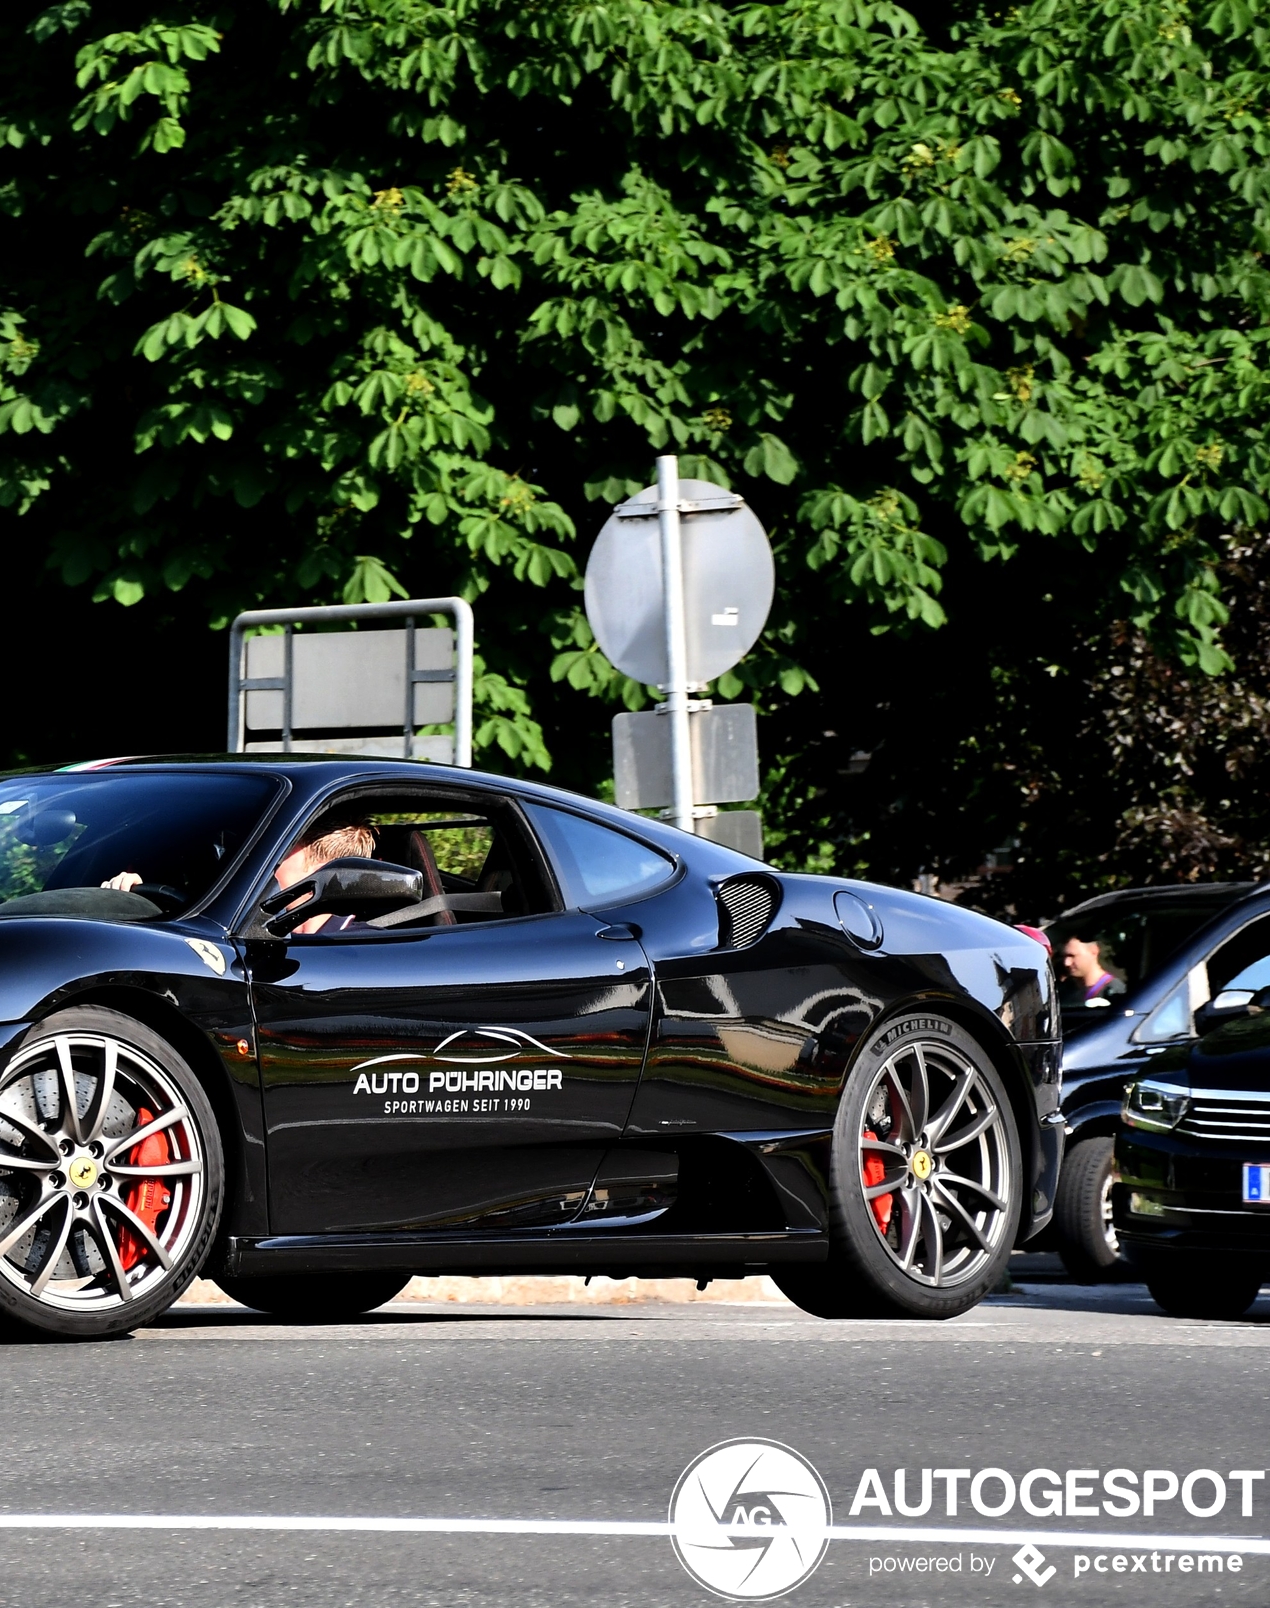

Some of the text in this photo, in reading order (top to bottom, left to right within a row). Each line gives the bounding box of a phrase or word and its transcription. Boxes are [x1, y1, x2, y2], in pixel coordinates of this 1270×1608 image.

[887, 1019, 949, 1043] MICHELIN
[352, 1069, 563, 1095] AUTO PÜHRINGER
[383, 1098, 531, 1114] SPORTWAGEN SEIT 1990
